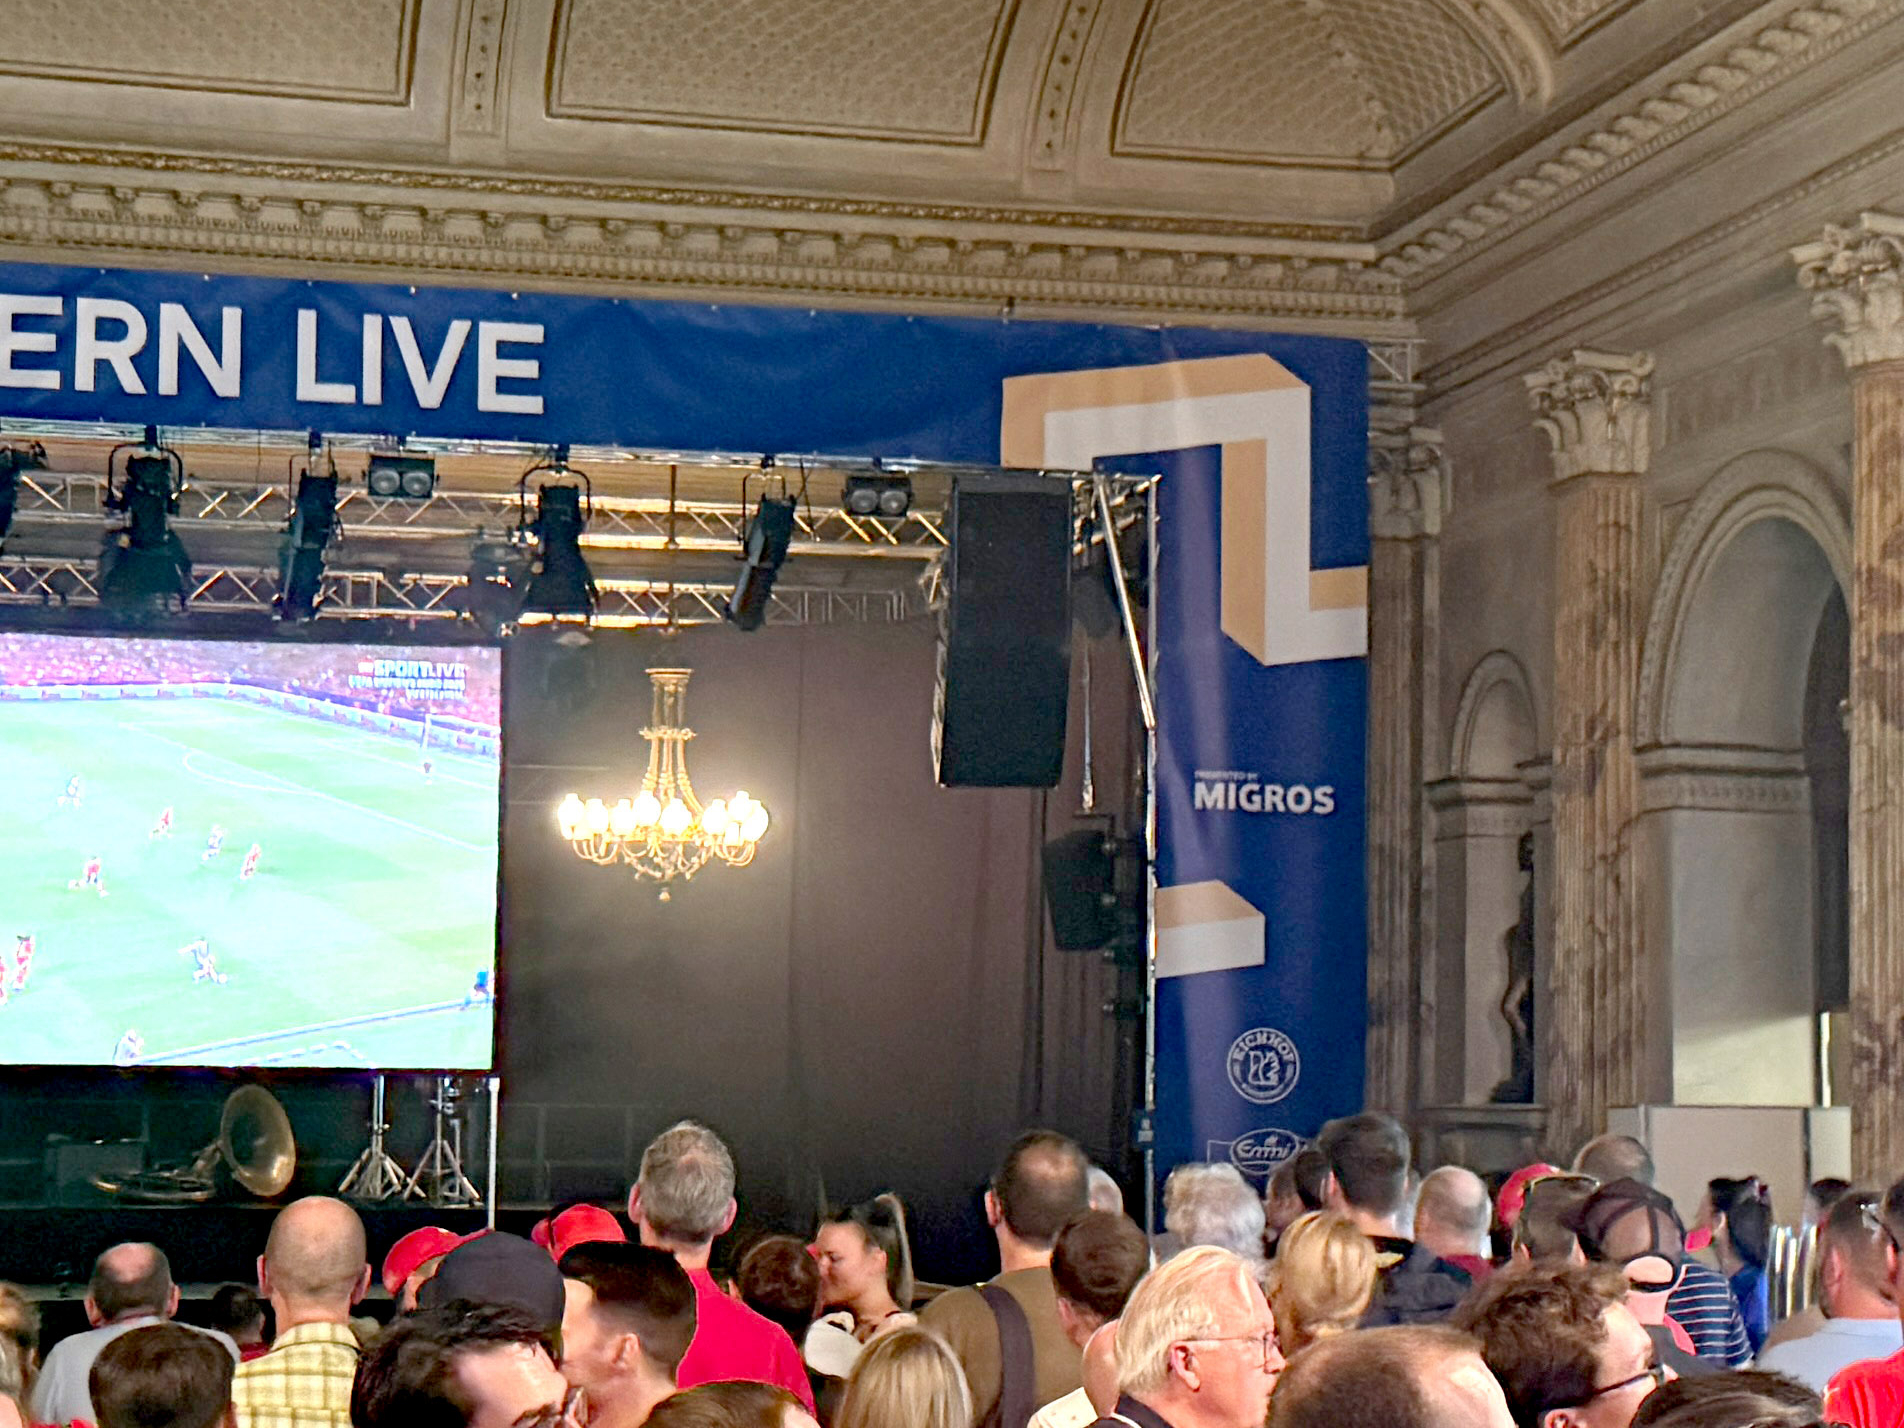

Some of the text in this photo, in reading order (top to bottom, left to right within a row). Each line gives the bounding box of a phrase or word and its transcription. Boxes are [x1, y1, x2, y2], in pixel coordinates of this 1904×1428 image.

[295, 307, 545, 416] LIVE
[1194, 781, 1336, 815] MIGROS
[1232, 1030, 1295, 1062] EICHHOF
[1235, 1138, 1292, 1160] Emmi
